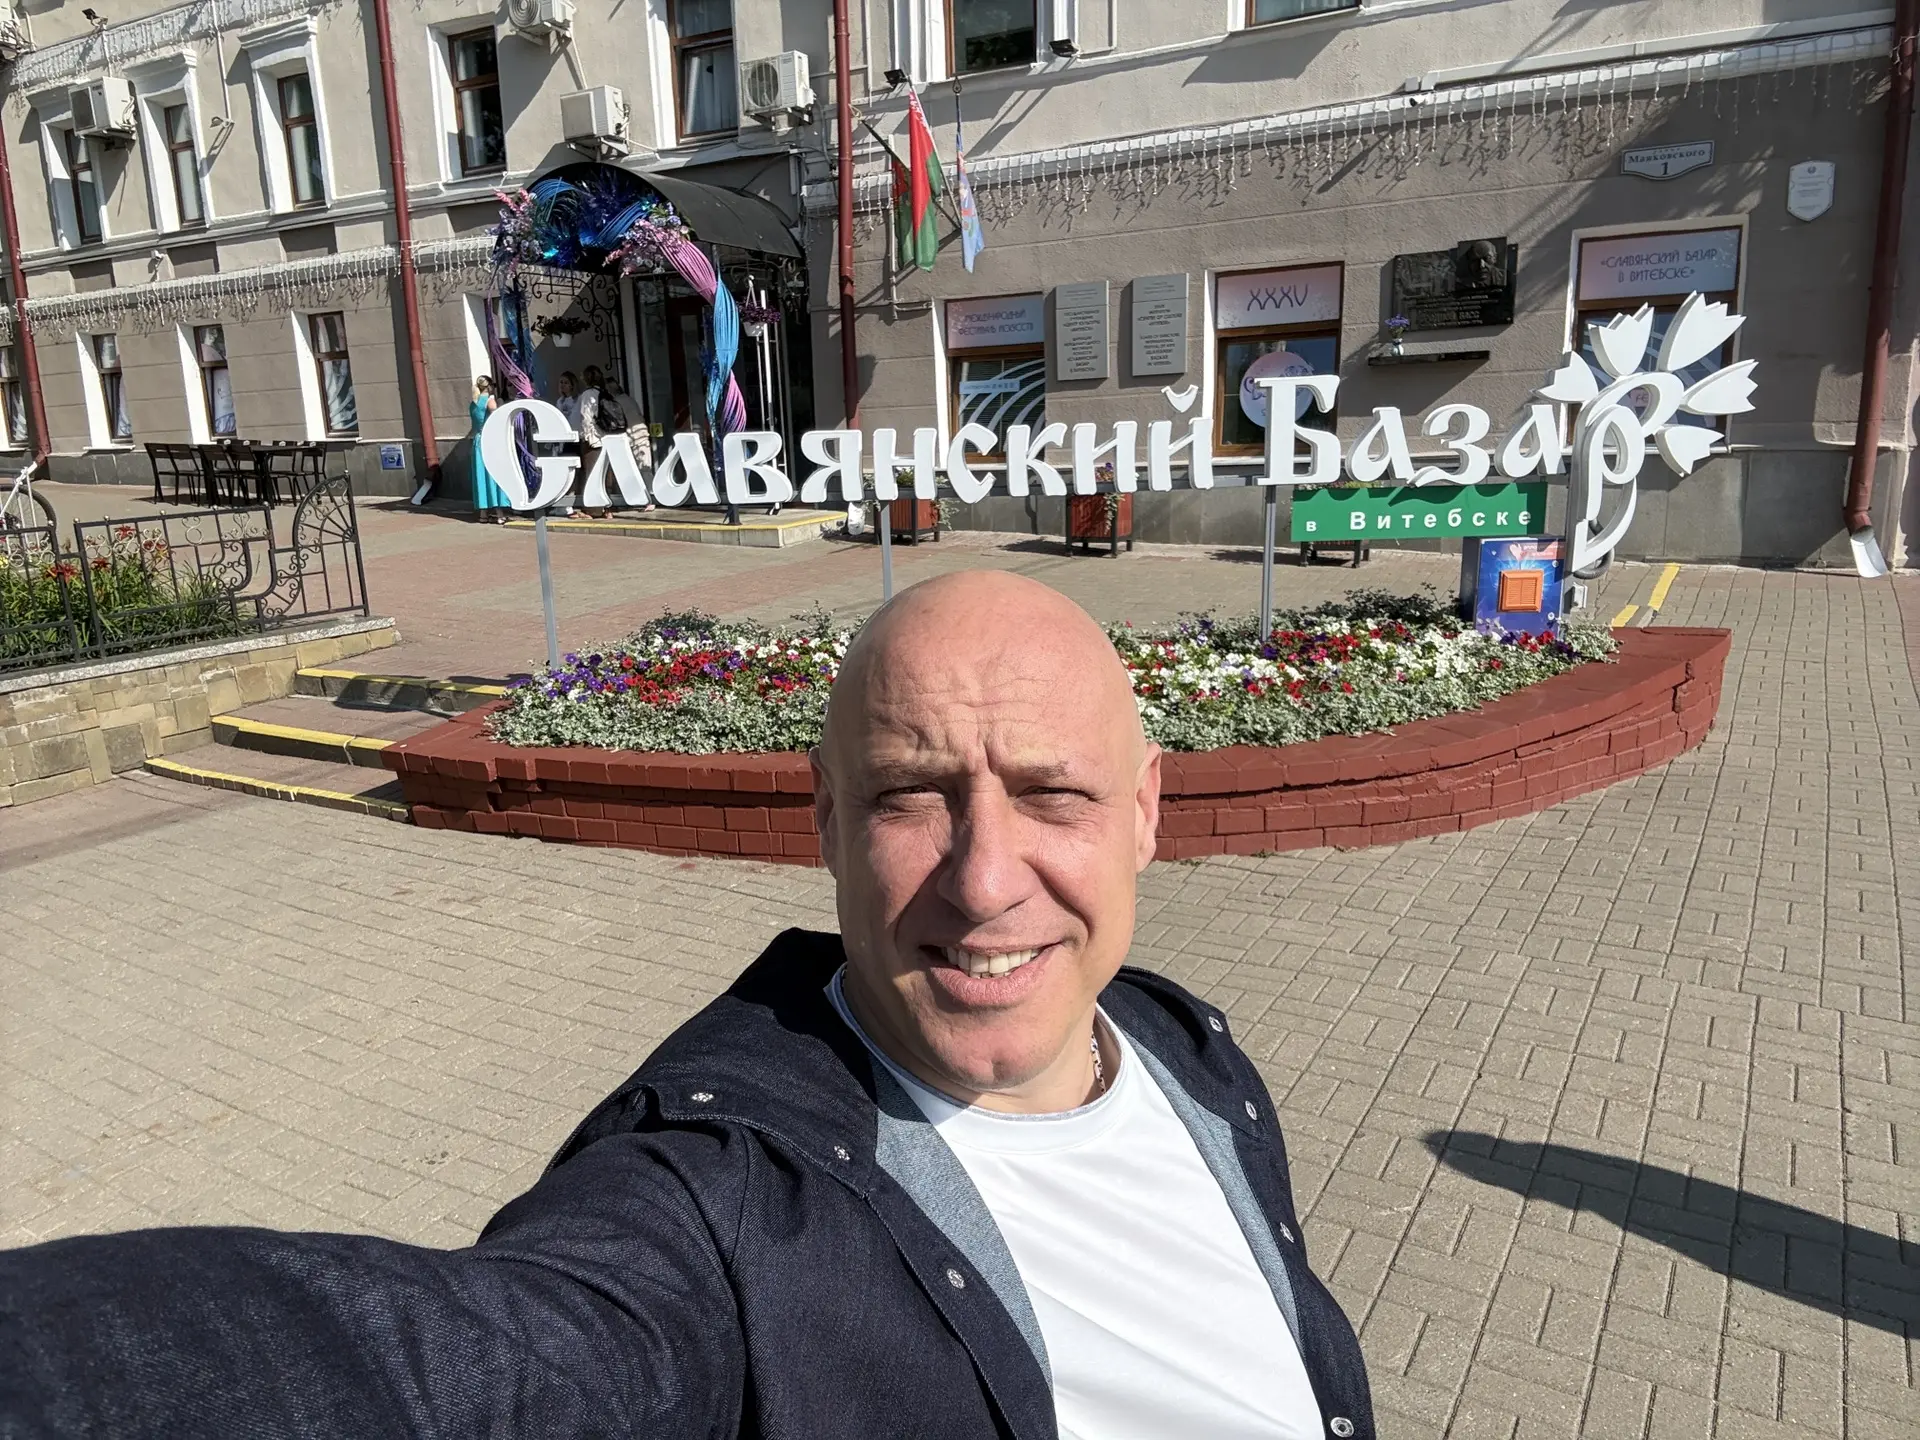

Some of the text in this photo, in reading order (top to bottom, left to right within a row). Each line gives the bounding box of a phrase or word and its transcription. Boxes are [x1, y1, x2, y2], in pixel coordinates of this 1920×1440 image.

[1628, 149, 1706, 164] Маяковского
[1661, 162, 1669, 176] 1
[1685, 248, 1718, 262] БАЗАР
[1247, 283, 1309, 311] XXXV
[481, 372, 1684, 577] Славянский Базар
[1305, 508, 1532, 532] в Витебске
